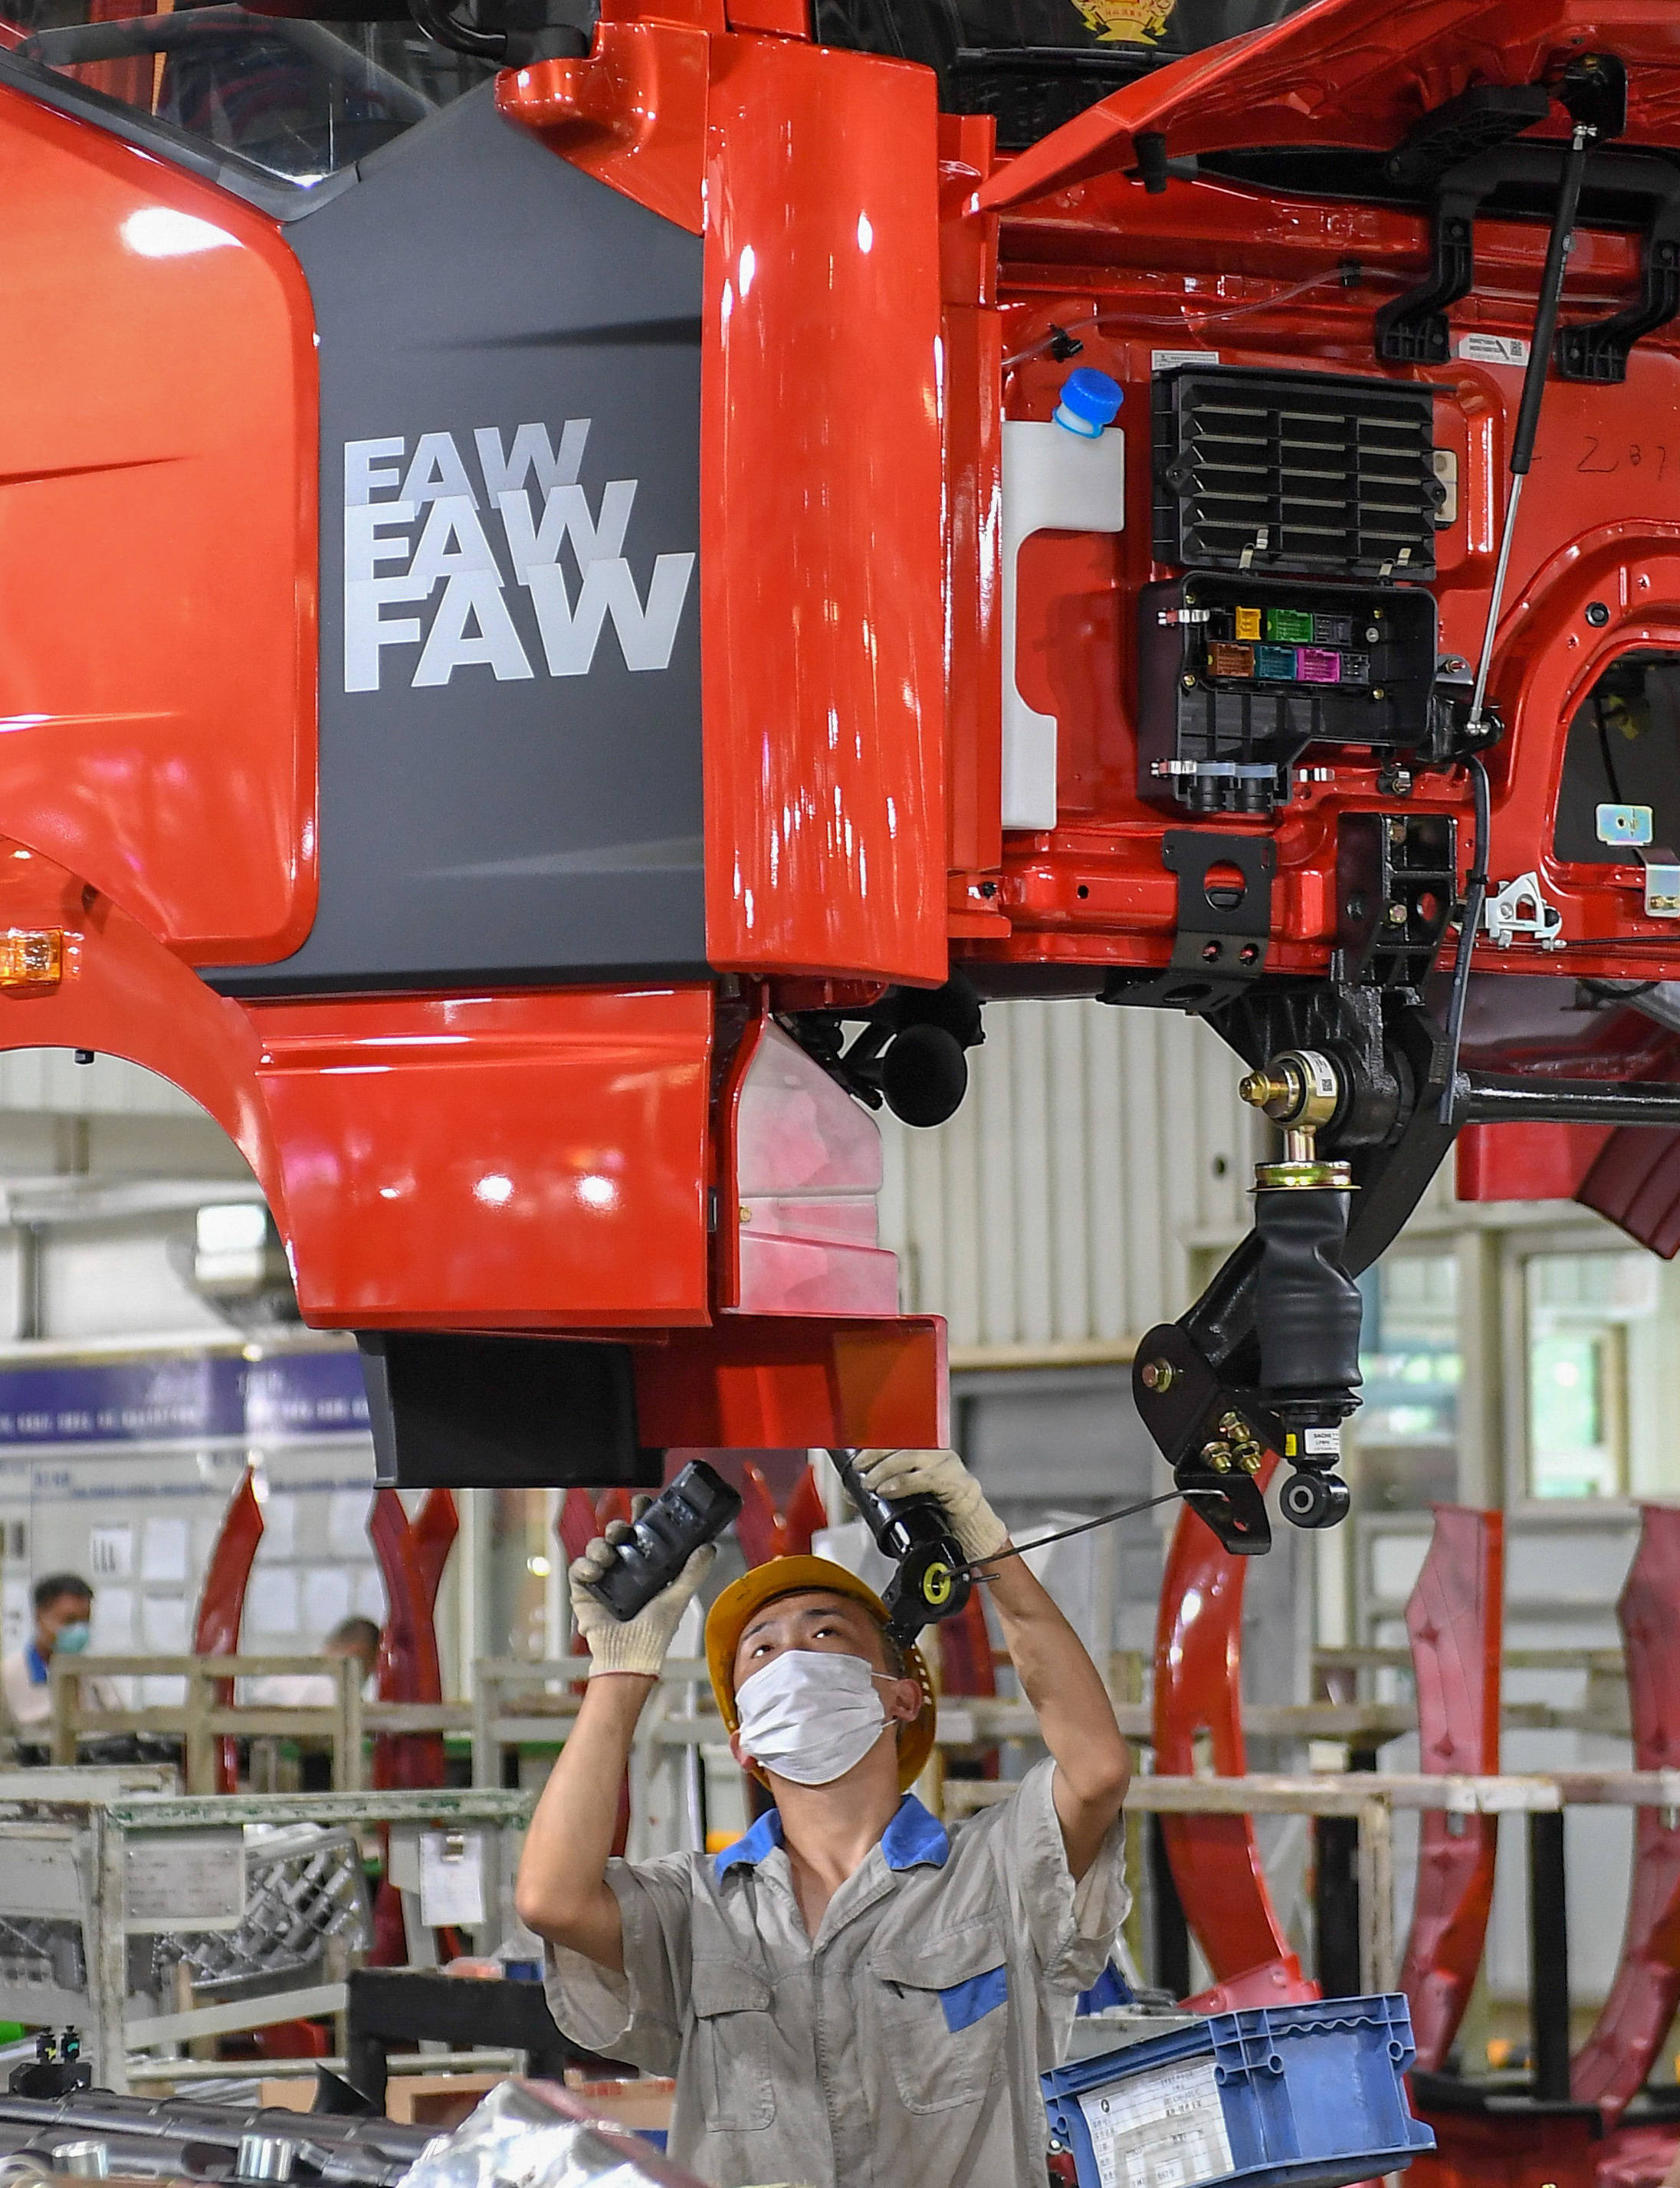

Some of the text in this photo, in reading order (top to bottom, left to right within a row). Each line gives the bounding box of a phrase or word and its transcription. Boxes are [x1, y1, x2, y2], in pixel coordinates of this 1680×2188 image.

[344, 418, 592, 516] FAW
[344, 478, 638, 593] FAW
[344, 552, 696, 692] FAW
